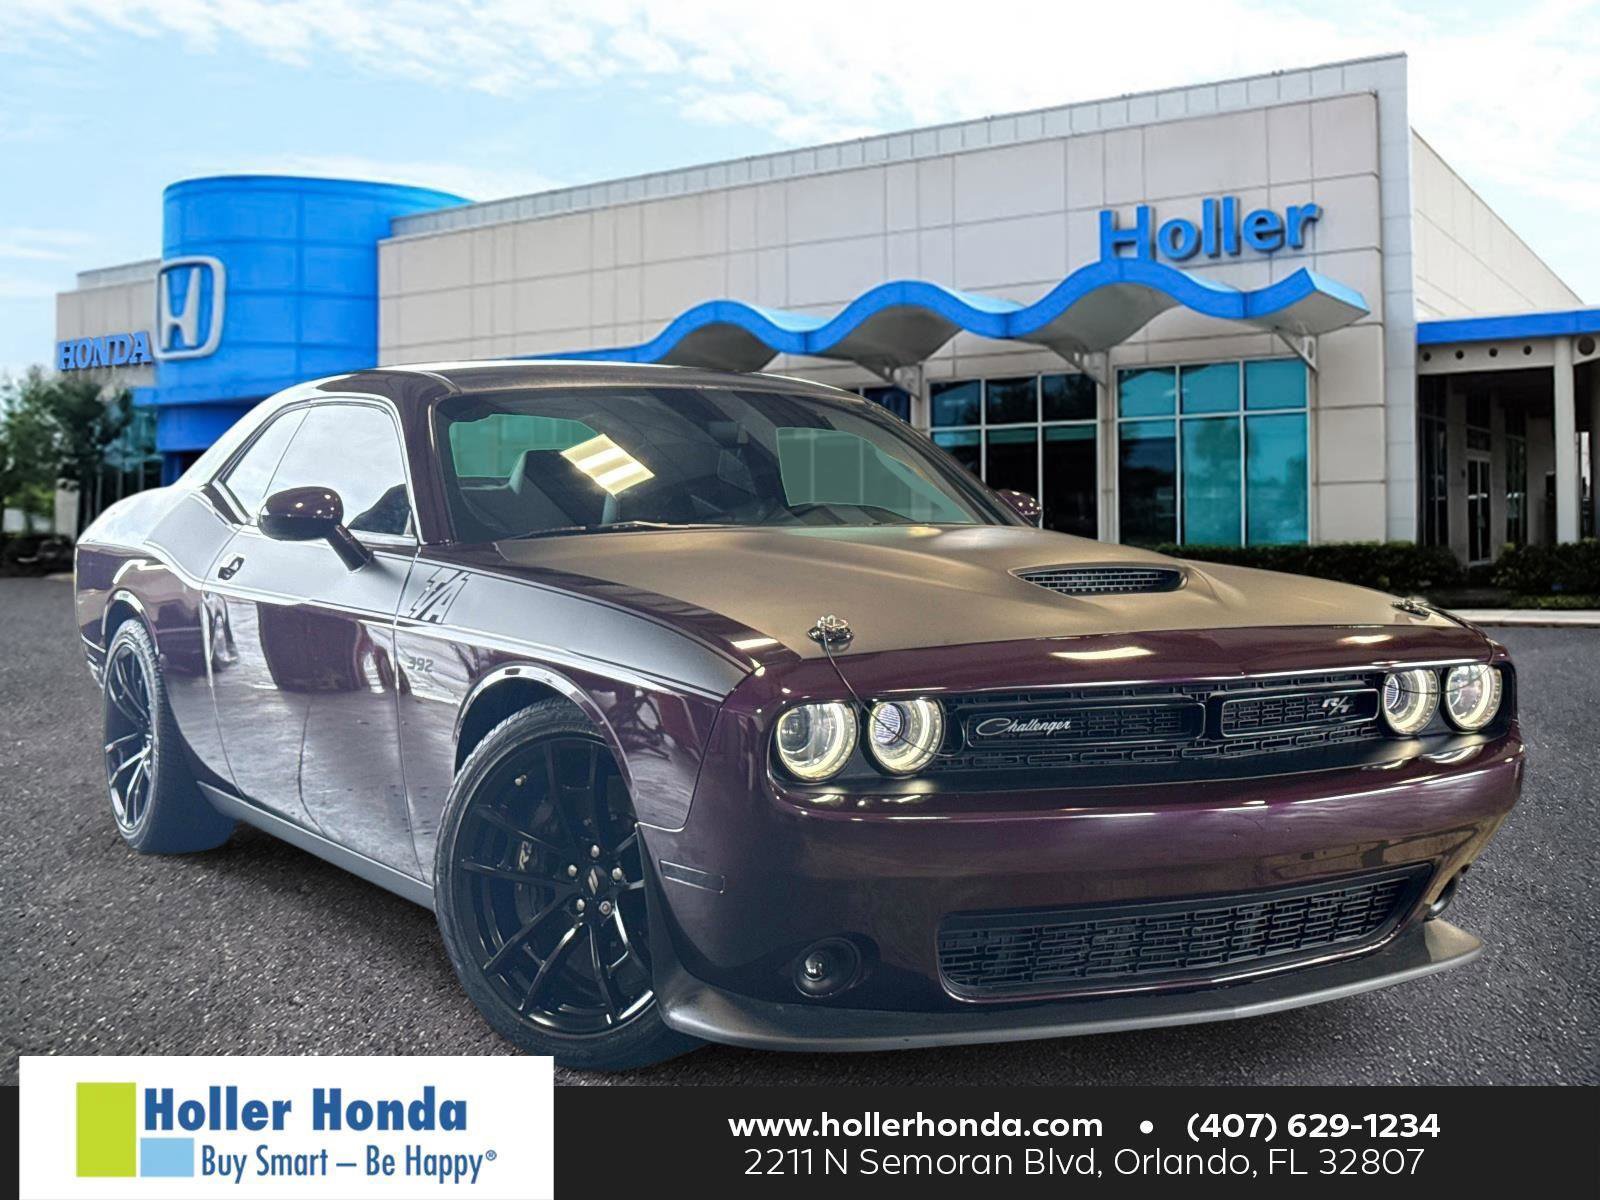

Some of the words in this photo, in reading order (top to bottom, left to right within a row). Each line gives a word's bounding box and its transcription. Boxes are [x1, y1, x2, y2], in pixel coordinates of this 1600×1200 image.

[1099, 195, 1321, 262] Holler
[57, 330, 153, 371] HONDA
[407, 656, 434, 673] 392
[1321, 695, 1350, 716] R/T
[975, 717, 1071, 736] Challenger
